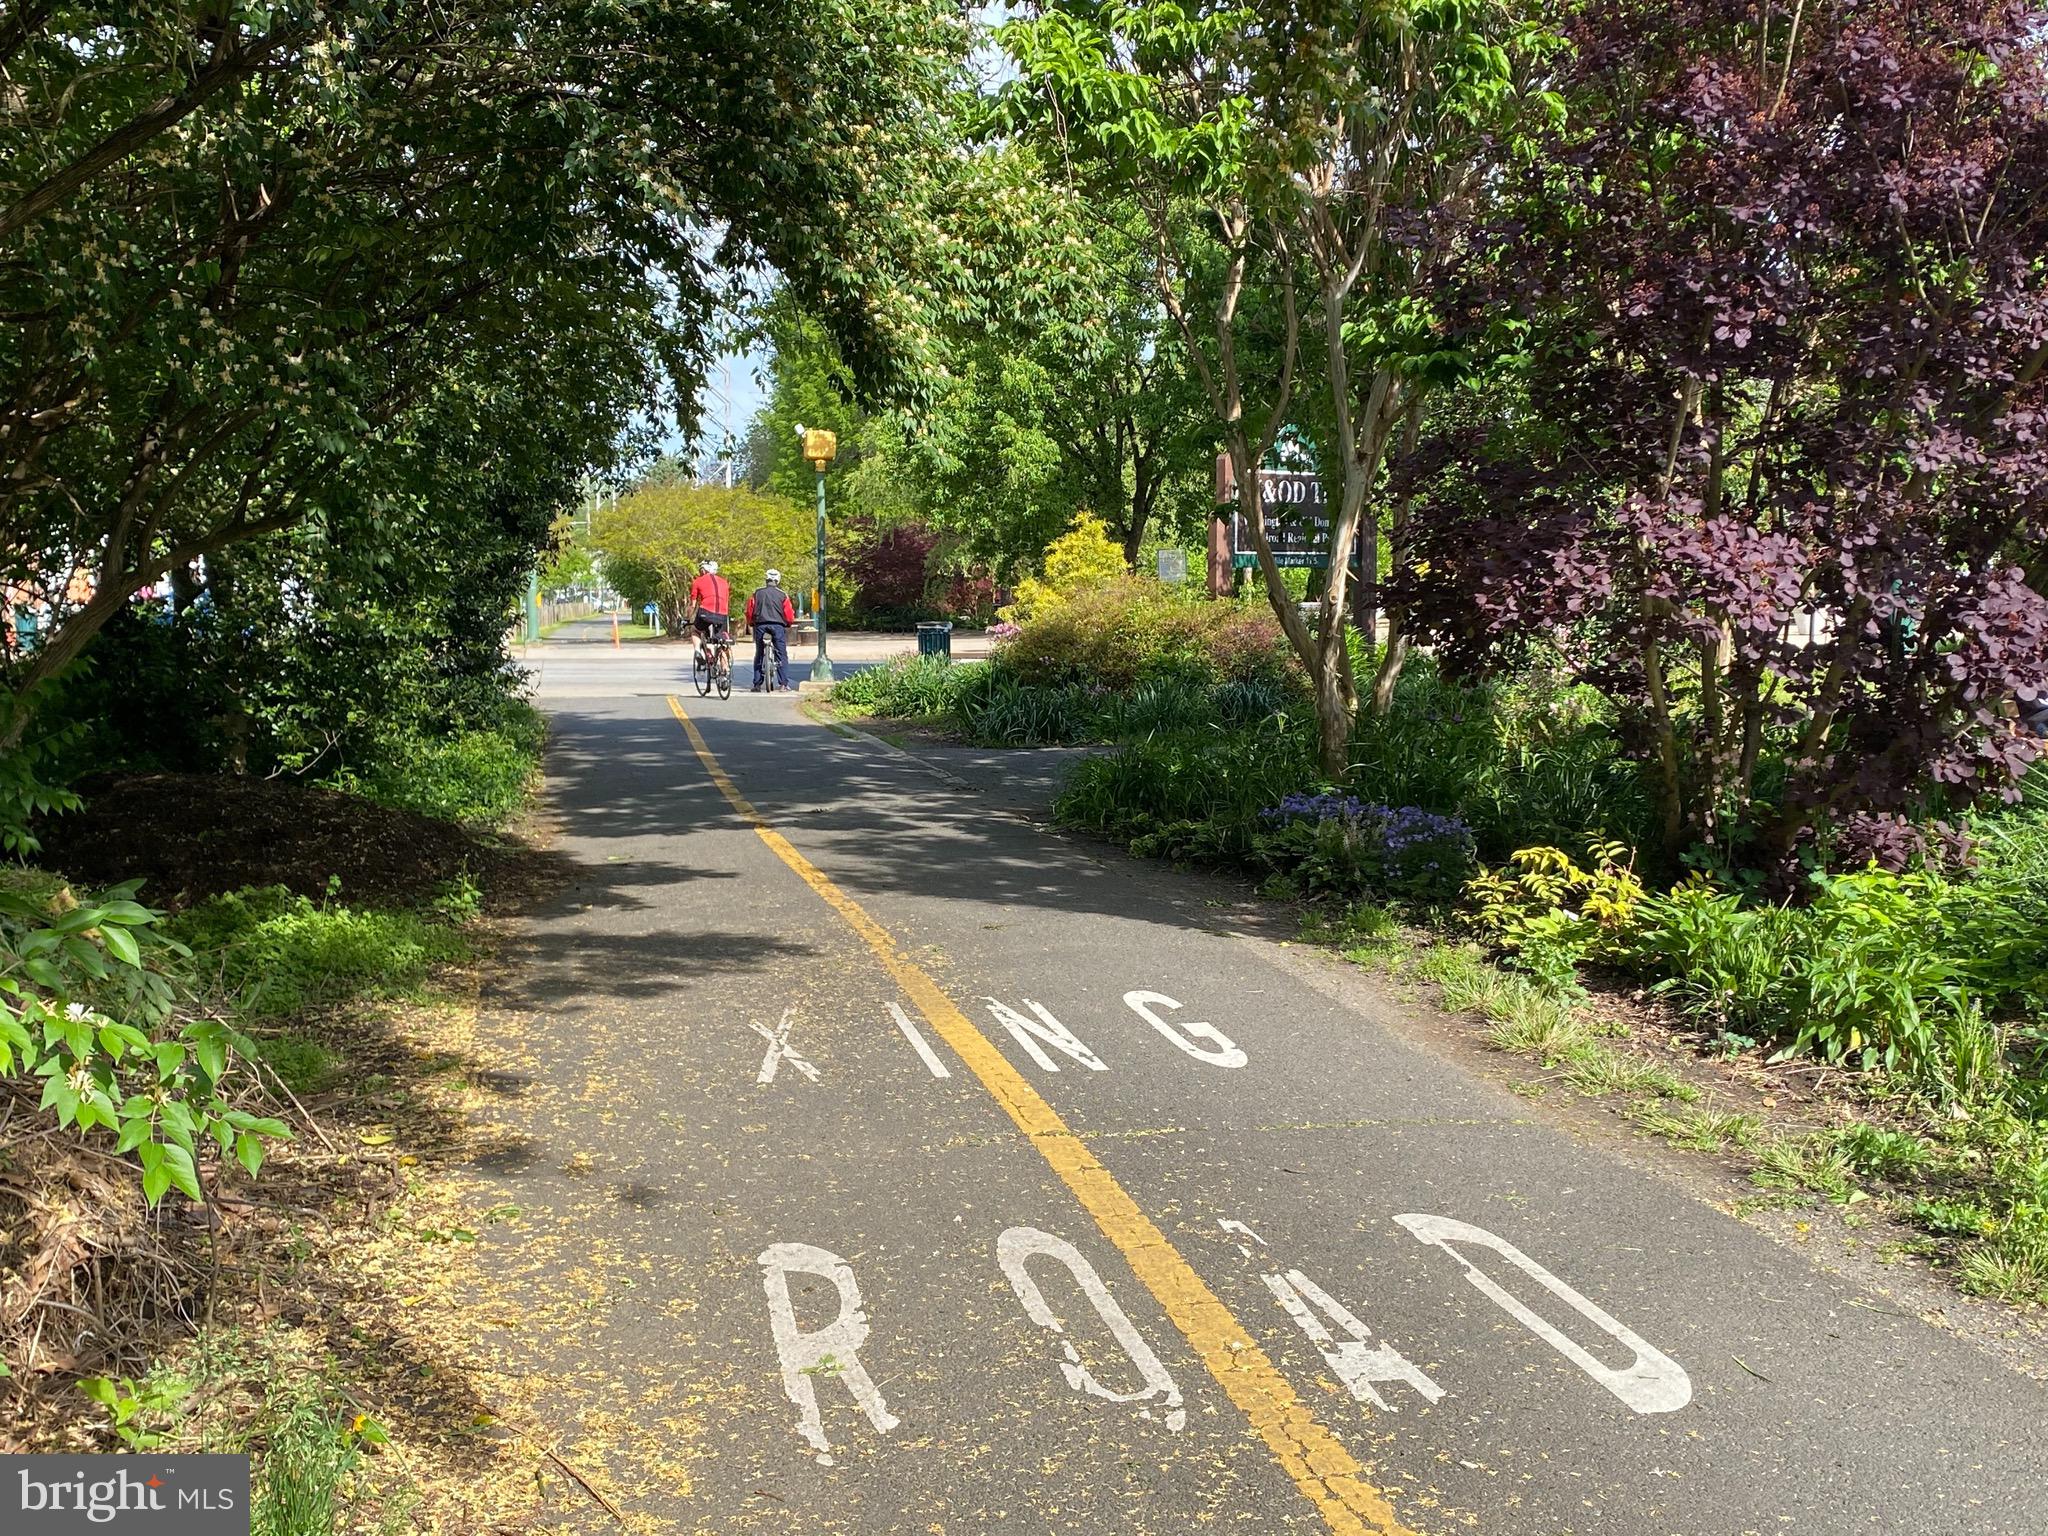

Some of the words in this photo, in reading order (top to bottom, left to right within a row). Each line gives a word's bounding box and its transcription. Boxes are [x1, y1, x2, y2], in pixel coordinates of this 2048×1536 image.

[1259, 479, 1306, 503] &OD
[748, 990, 1248, 1083] XING
[757, 1212, 1694, 1466] ROAD
